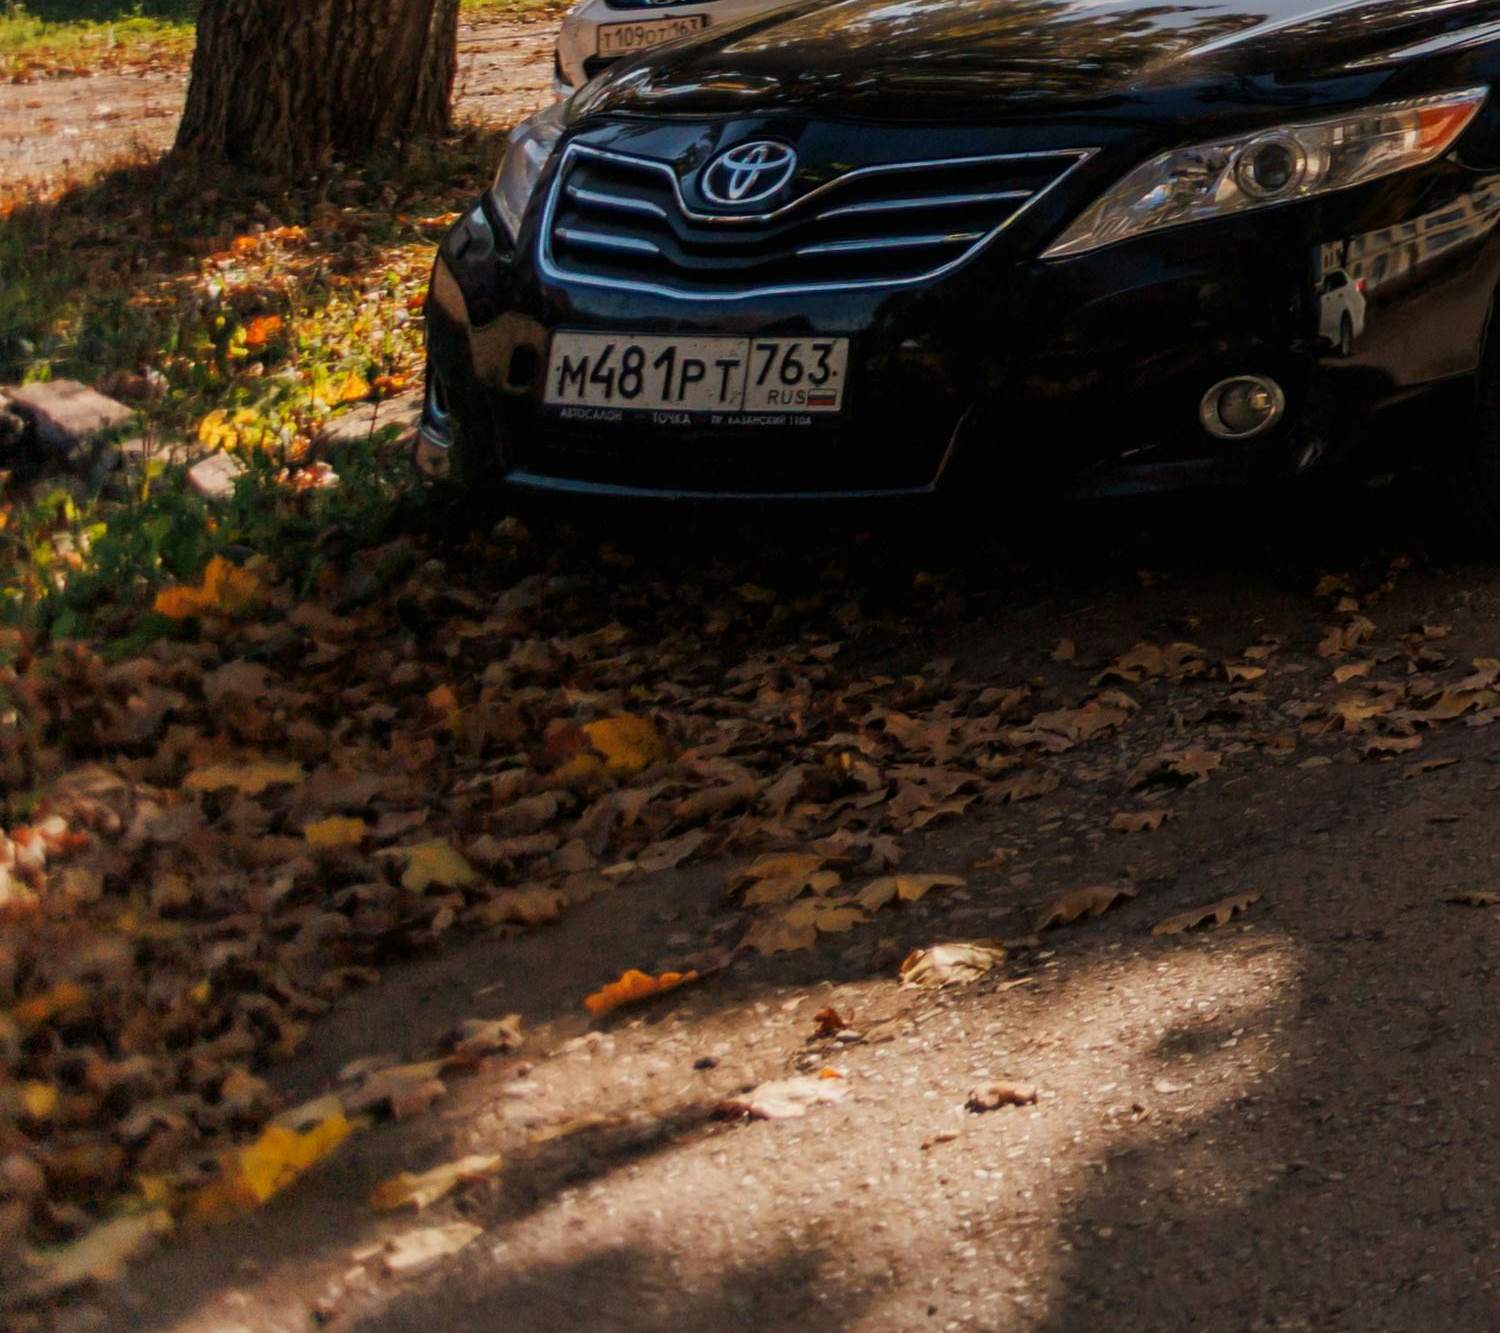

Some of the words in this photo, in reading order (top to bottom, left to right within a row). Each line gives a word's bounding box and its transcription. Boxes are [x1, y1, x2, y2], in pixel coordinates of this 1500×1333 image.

[557, 343, 742, 402] М481РТ
[755, 342, 834, 386] 763
[766, 388, 806, 406] RUS
[652, 411, 692, 425] ТОЧКА
